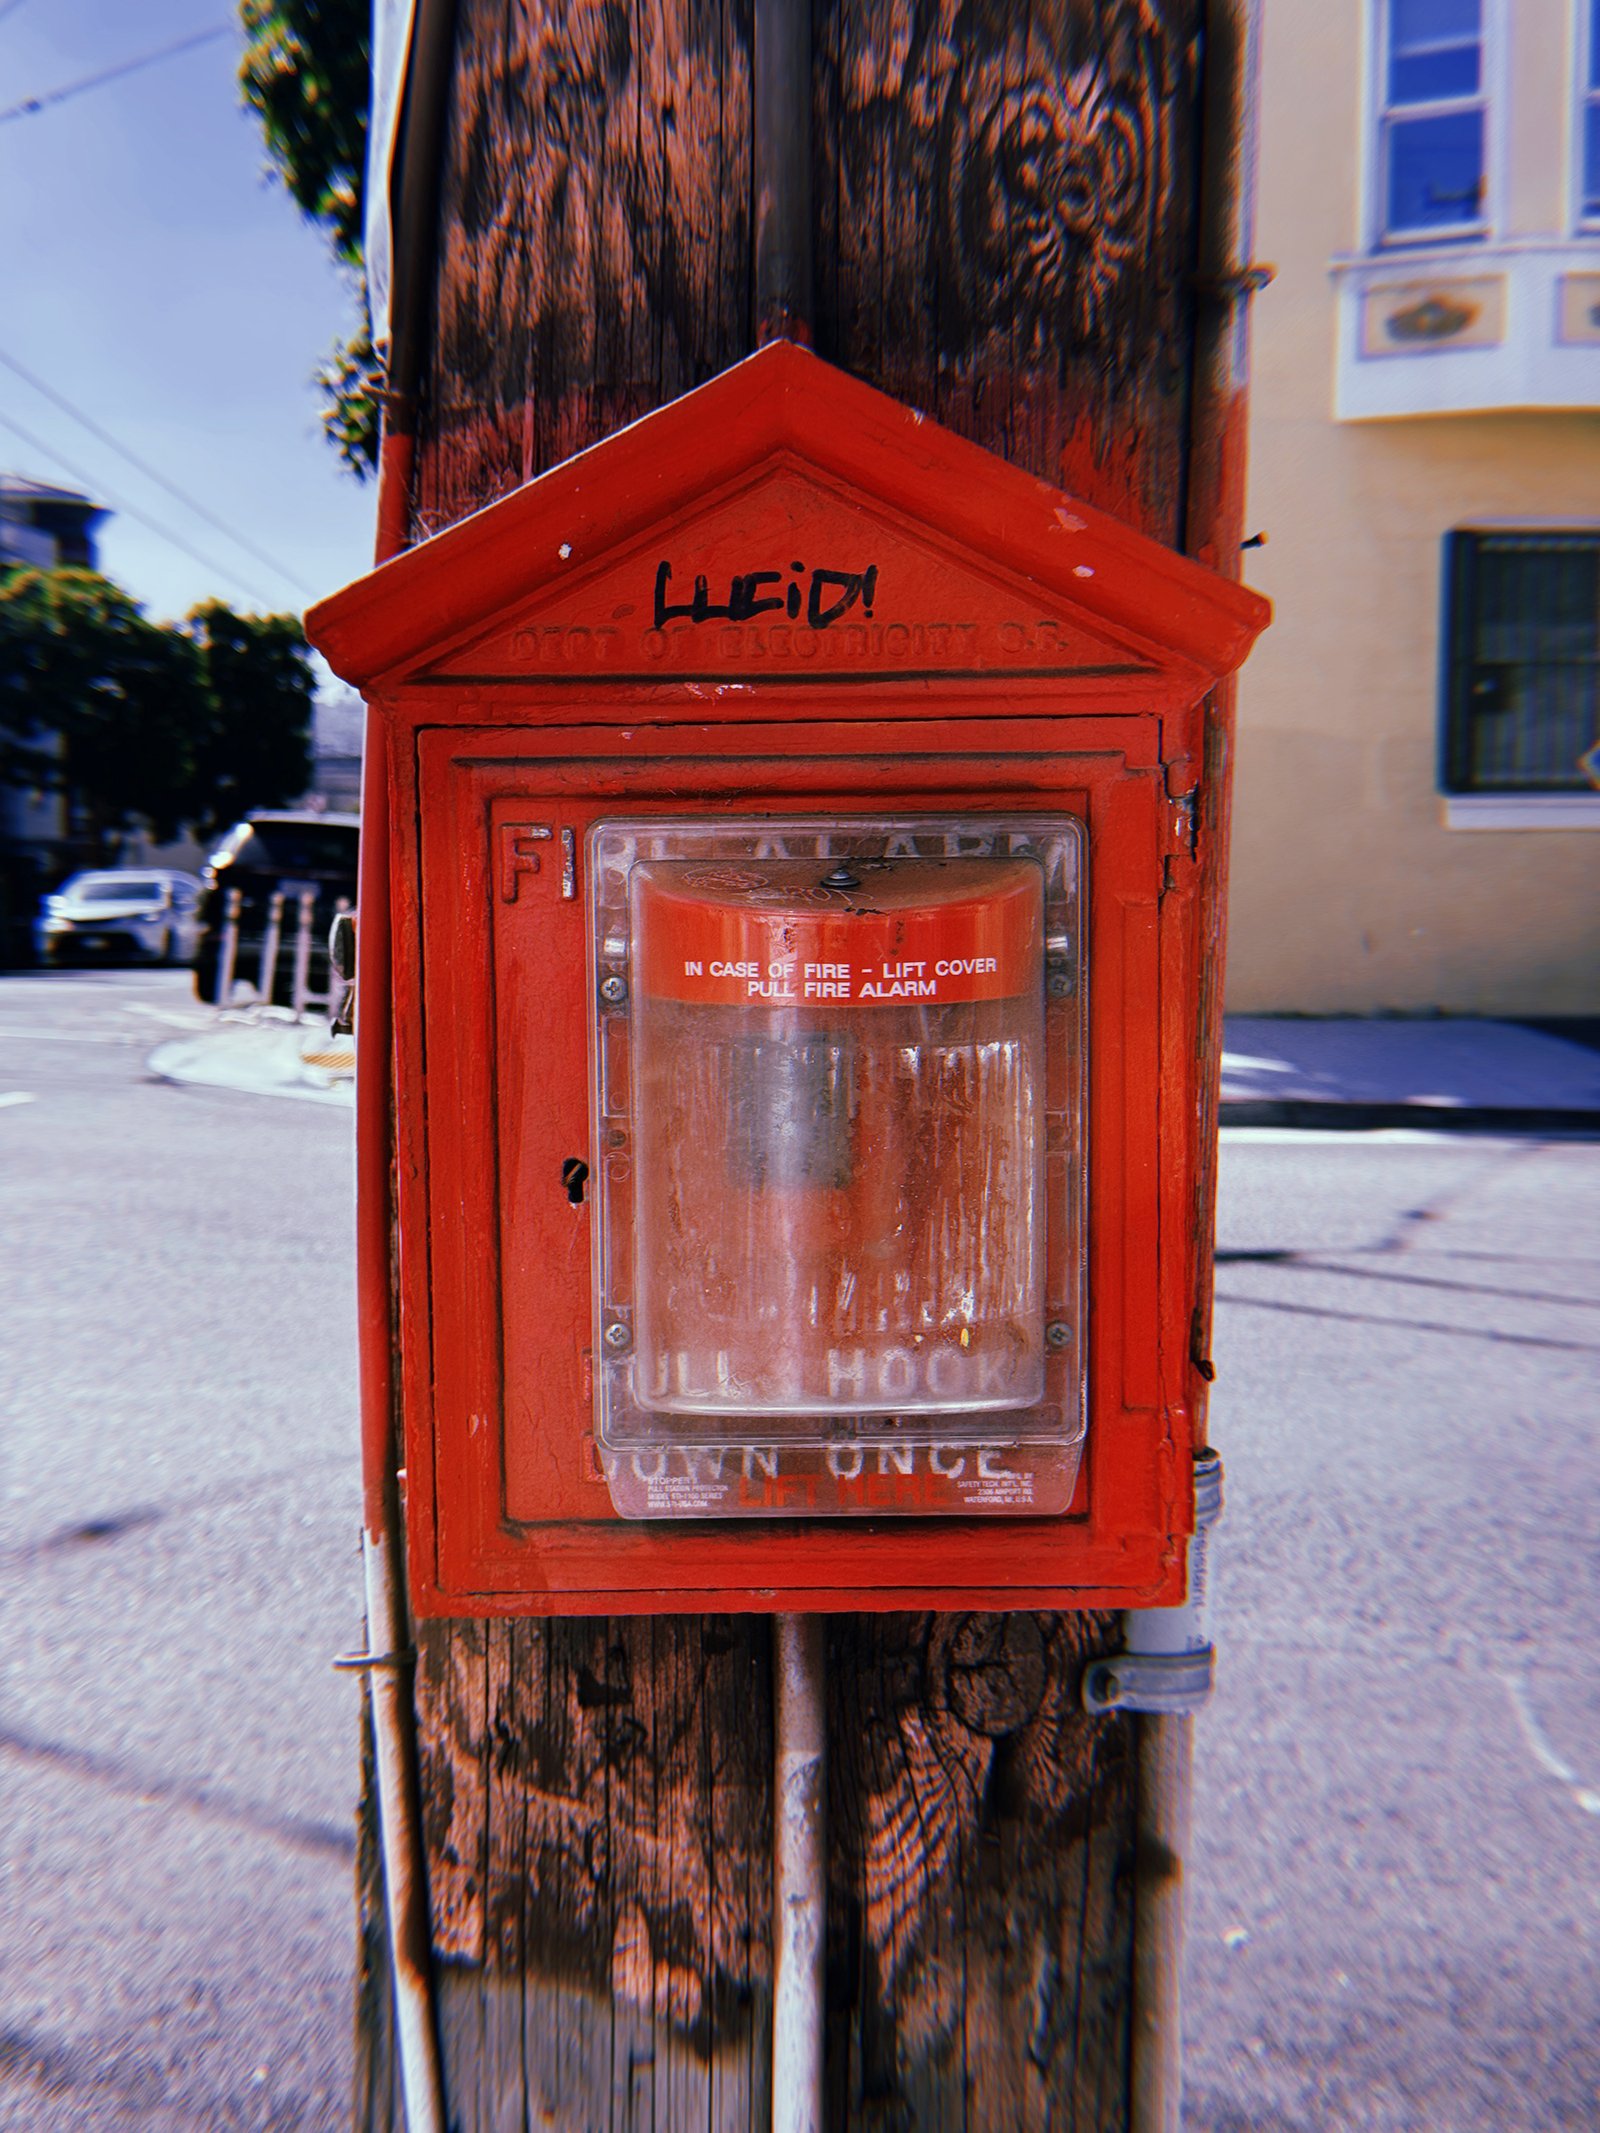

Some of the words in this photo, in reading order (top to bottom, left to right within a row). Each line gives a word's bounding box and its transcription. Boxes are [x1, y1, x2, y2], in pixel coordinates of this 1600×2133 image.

[684, 960, 704, 976] IN
[709, 961, 758, 979] CASE
[768, 963, 794, 980] OF
[804, 962, 851, 980] FIRE
[883, 961, 926, 979] LIFT
[935, 958, 997, 976] COVER
[747, 980, 795, 998] PULL
[804, 980, 851, 998] FIRE
[859, 980, 937, 997] ALARM
[827, 1346, 1008, 1399] HOOK
[738, 1472, 823, 1508] LIFT
[838, 1472, 952, 1507] HERE
